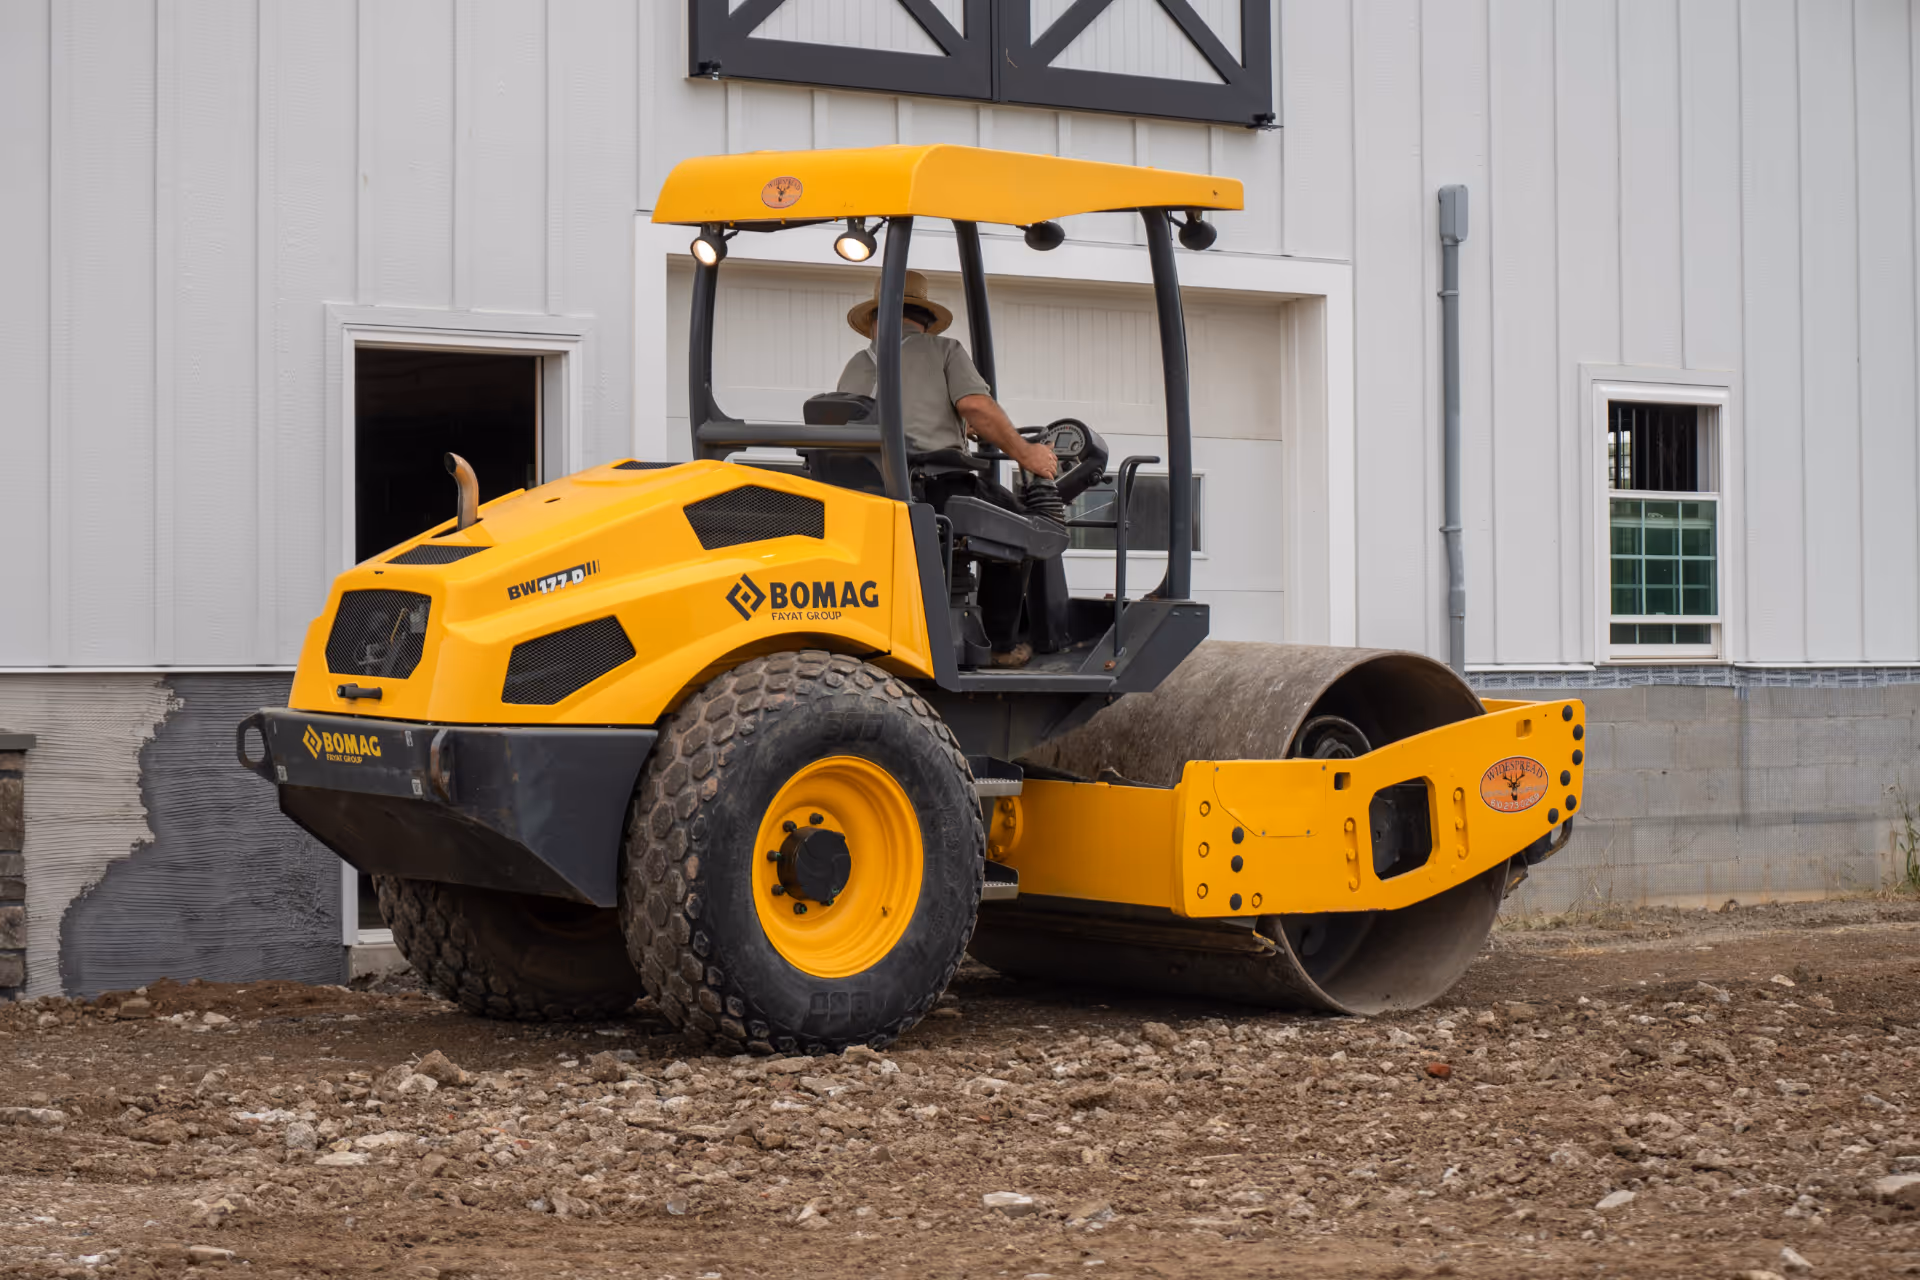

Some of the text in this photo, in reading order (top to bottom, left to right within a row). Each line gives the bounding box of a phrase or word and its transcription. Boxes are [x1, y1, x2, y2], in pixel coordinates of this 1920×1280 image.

[769, 580, 879, 609] BOMAG
[771, 611, 842, 621] FAYAT GROUP
[321, 731, 382, 757] BOMAG
[343, 755, 363, 764] GROUP
[1486, 760, 1543, 781] WIDESPREAD
